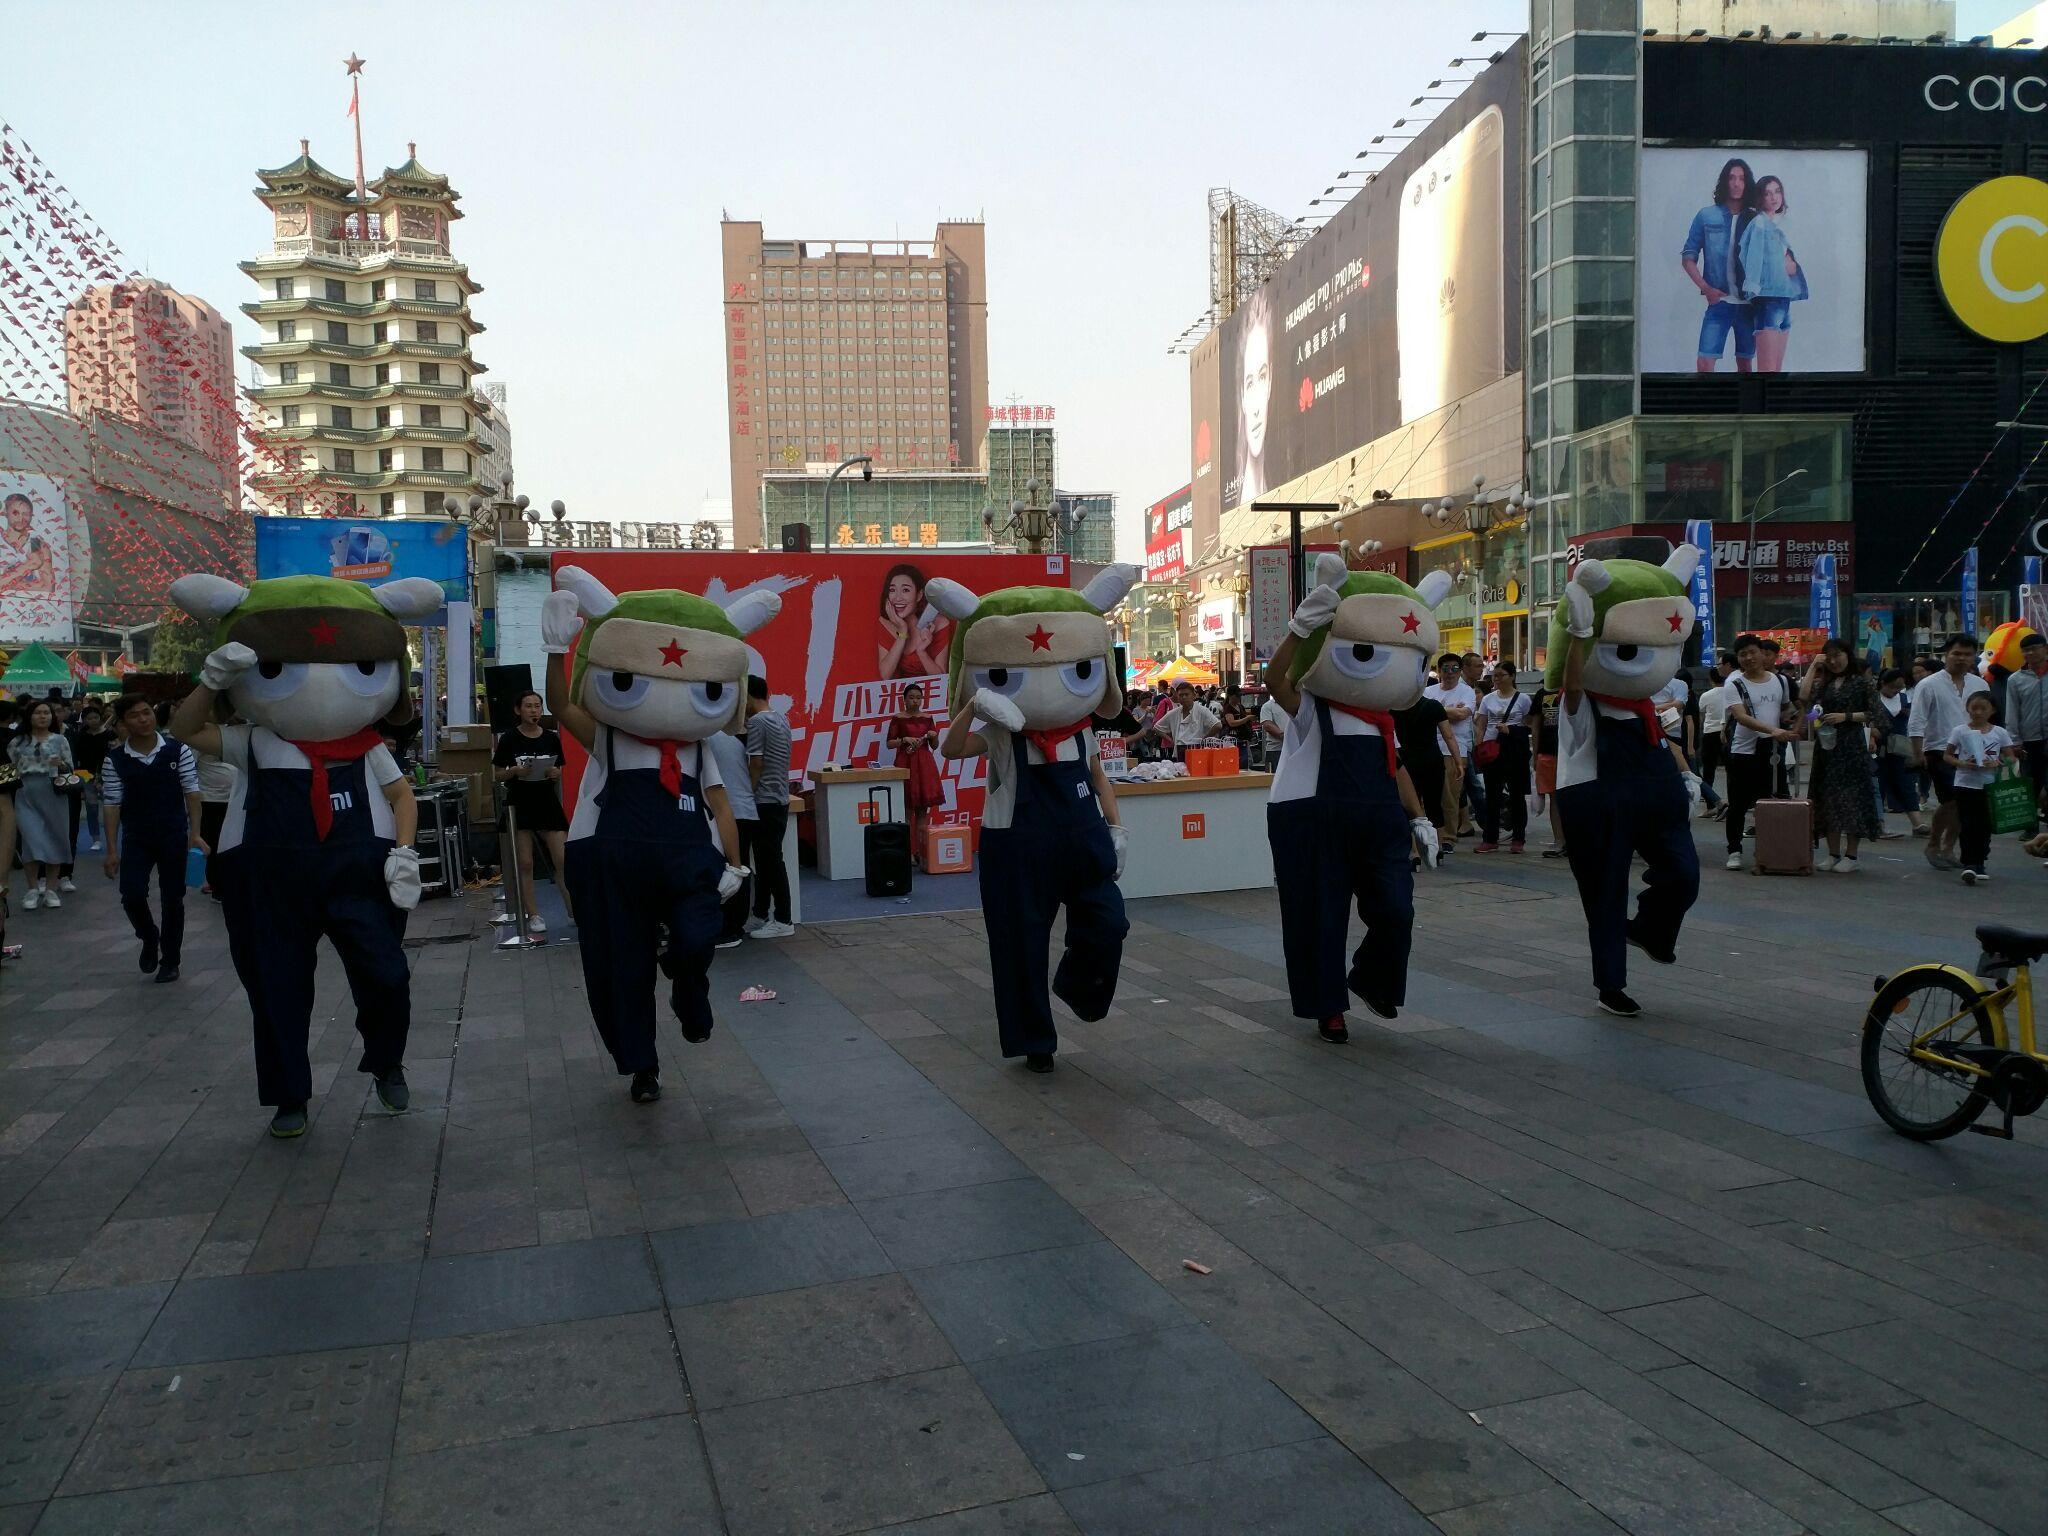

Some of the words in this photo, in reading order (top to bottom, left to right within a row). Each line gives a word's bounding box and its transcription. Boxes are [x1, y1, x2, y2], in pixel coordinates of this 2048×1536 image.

[1285, 293, 1316, 332] HUAWEI
[1315, 366, 1346, 399] HUAWEI
[984, 405, 1056, 421] 商城快捷酒店
[837, 523, 939, 546] 永乐电器
[1681, 540, 1780, 569] 视通
[1786, 554, 1849, 568] 眼镜市
[843, 676, 949, 715] 小米手
